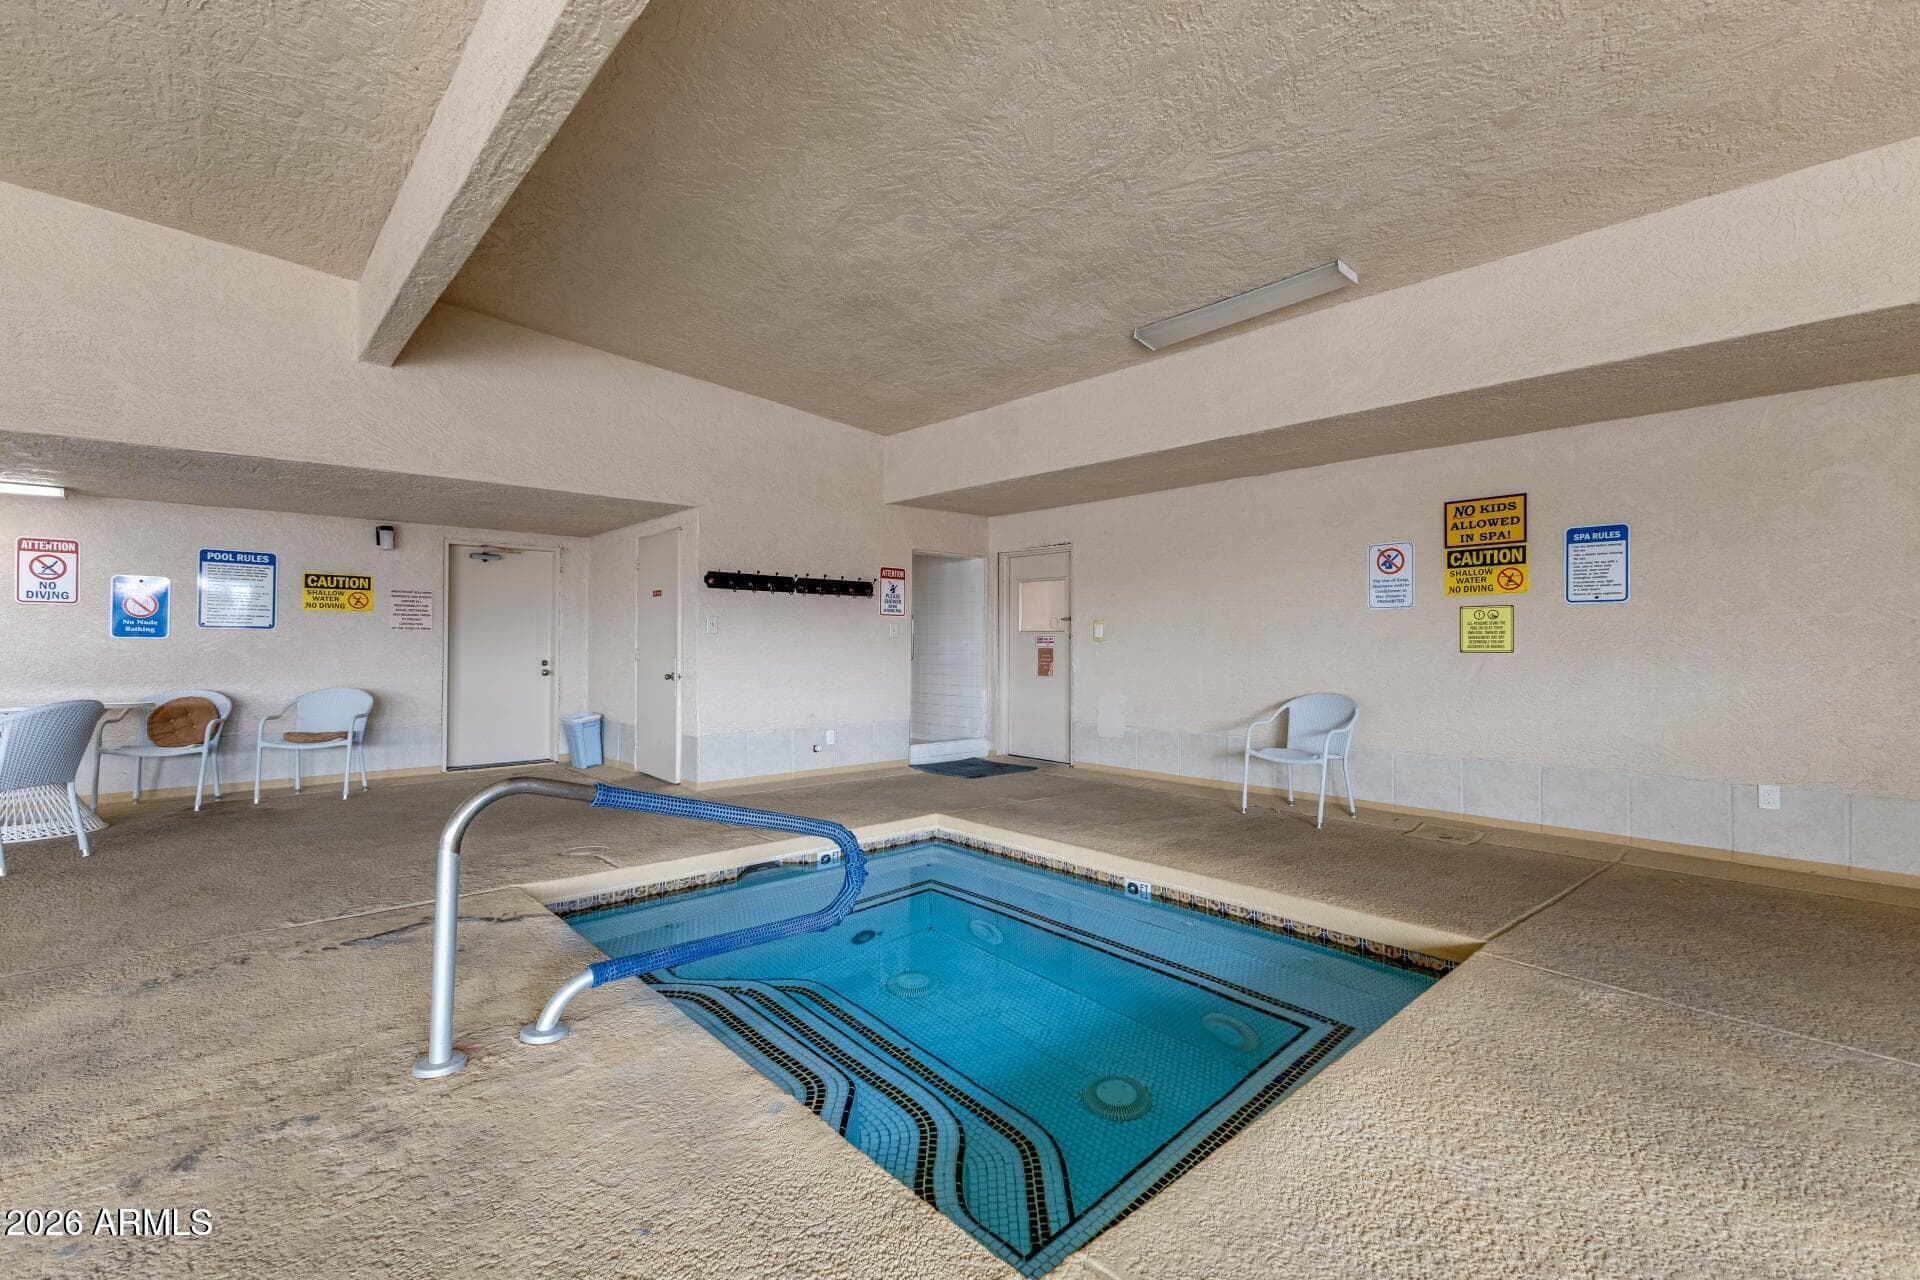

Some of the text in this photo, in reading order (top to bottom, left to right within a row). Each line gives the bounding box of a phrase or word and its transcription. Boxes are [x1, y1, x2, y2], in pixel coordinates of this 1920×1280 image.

[1453, 502, 1516, 518] NO KIDS
[1451, 516, 1520, 531] ALLOWED
[1460, 531, 1511, 542] IN SPA!
[1573, 531, 1621, 541] SPA RULES
[21, 541, 76, 551] ATTENTION
[207, 552, 269, 563] POOL RULES
[1450, 548, 1523, 566] CAUTION
[1449, 568, 1493, 577] SHALLOW
[39, 581, 57, 590] NO
[307, 575, 369, 589] CAUTION
[306, 589, 345, 597] SHALLOW
[1464, 585, 1494, 593] DIVING
[26, 590, 70, 600] DIVING
